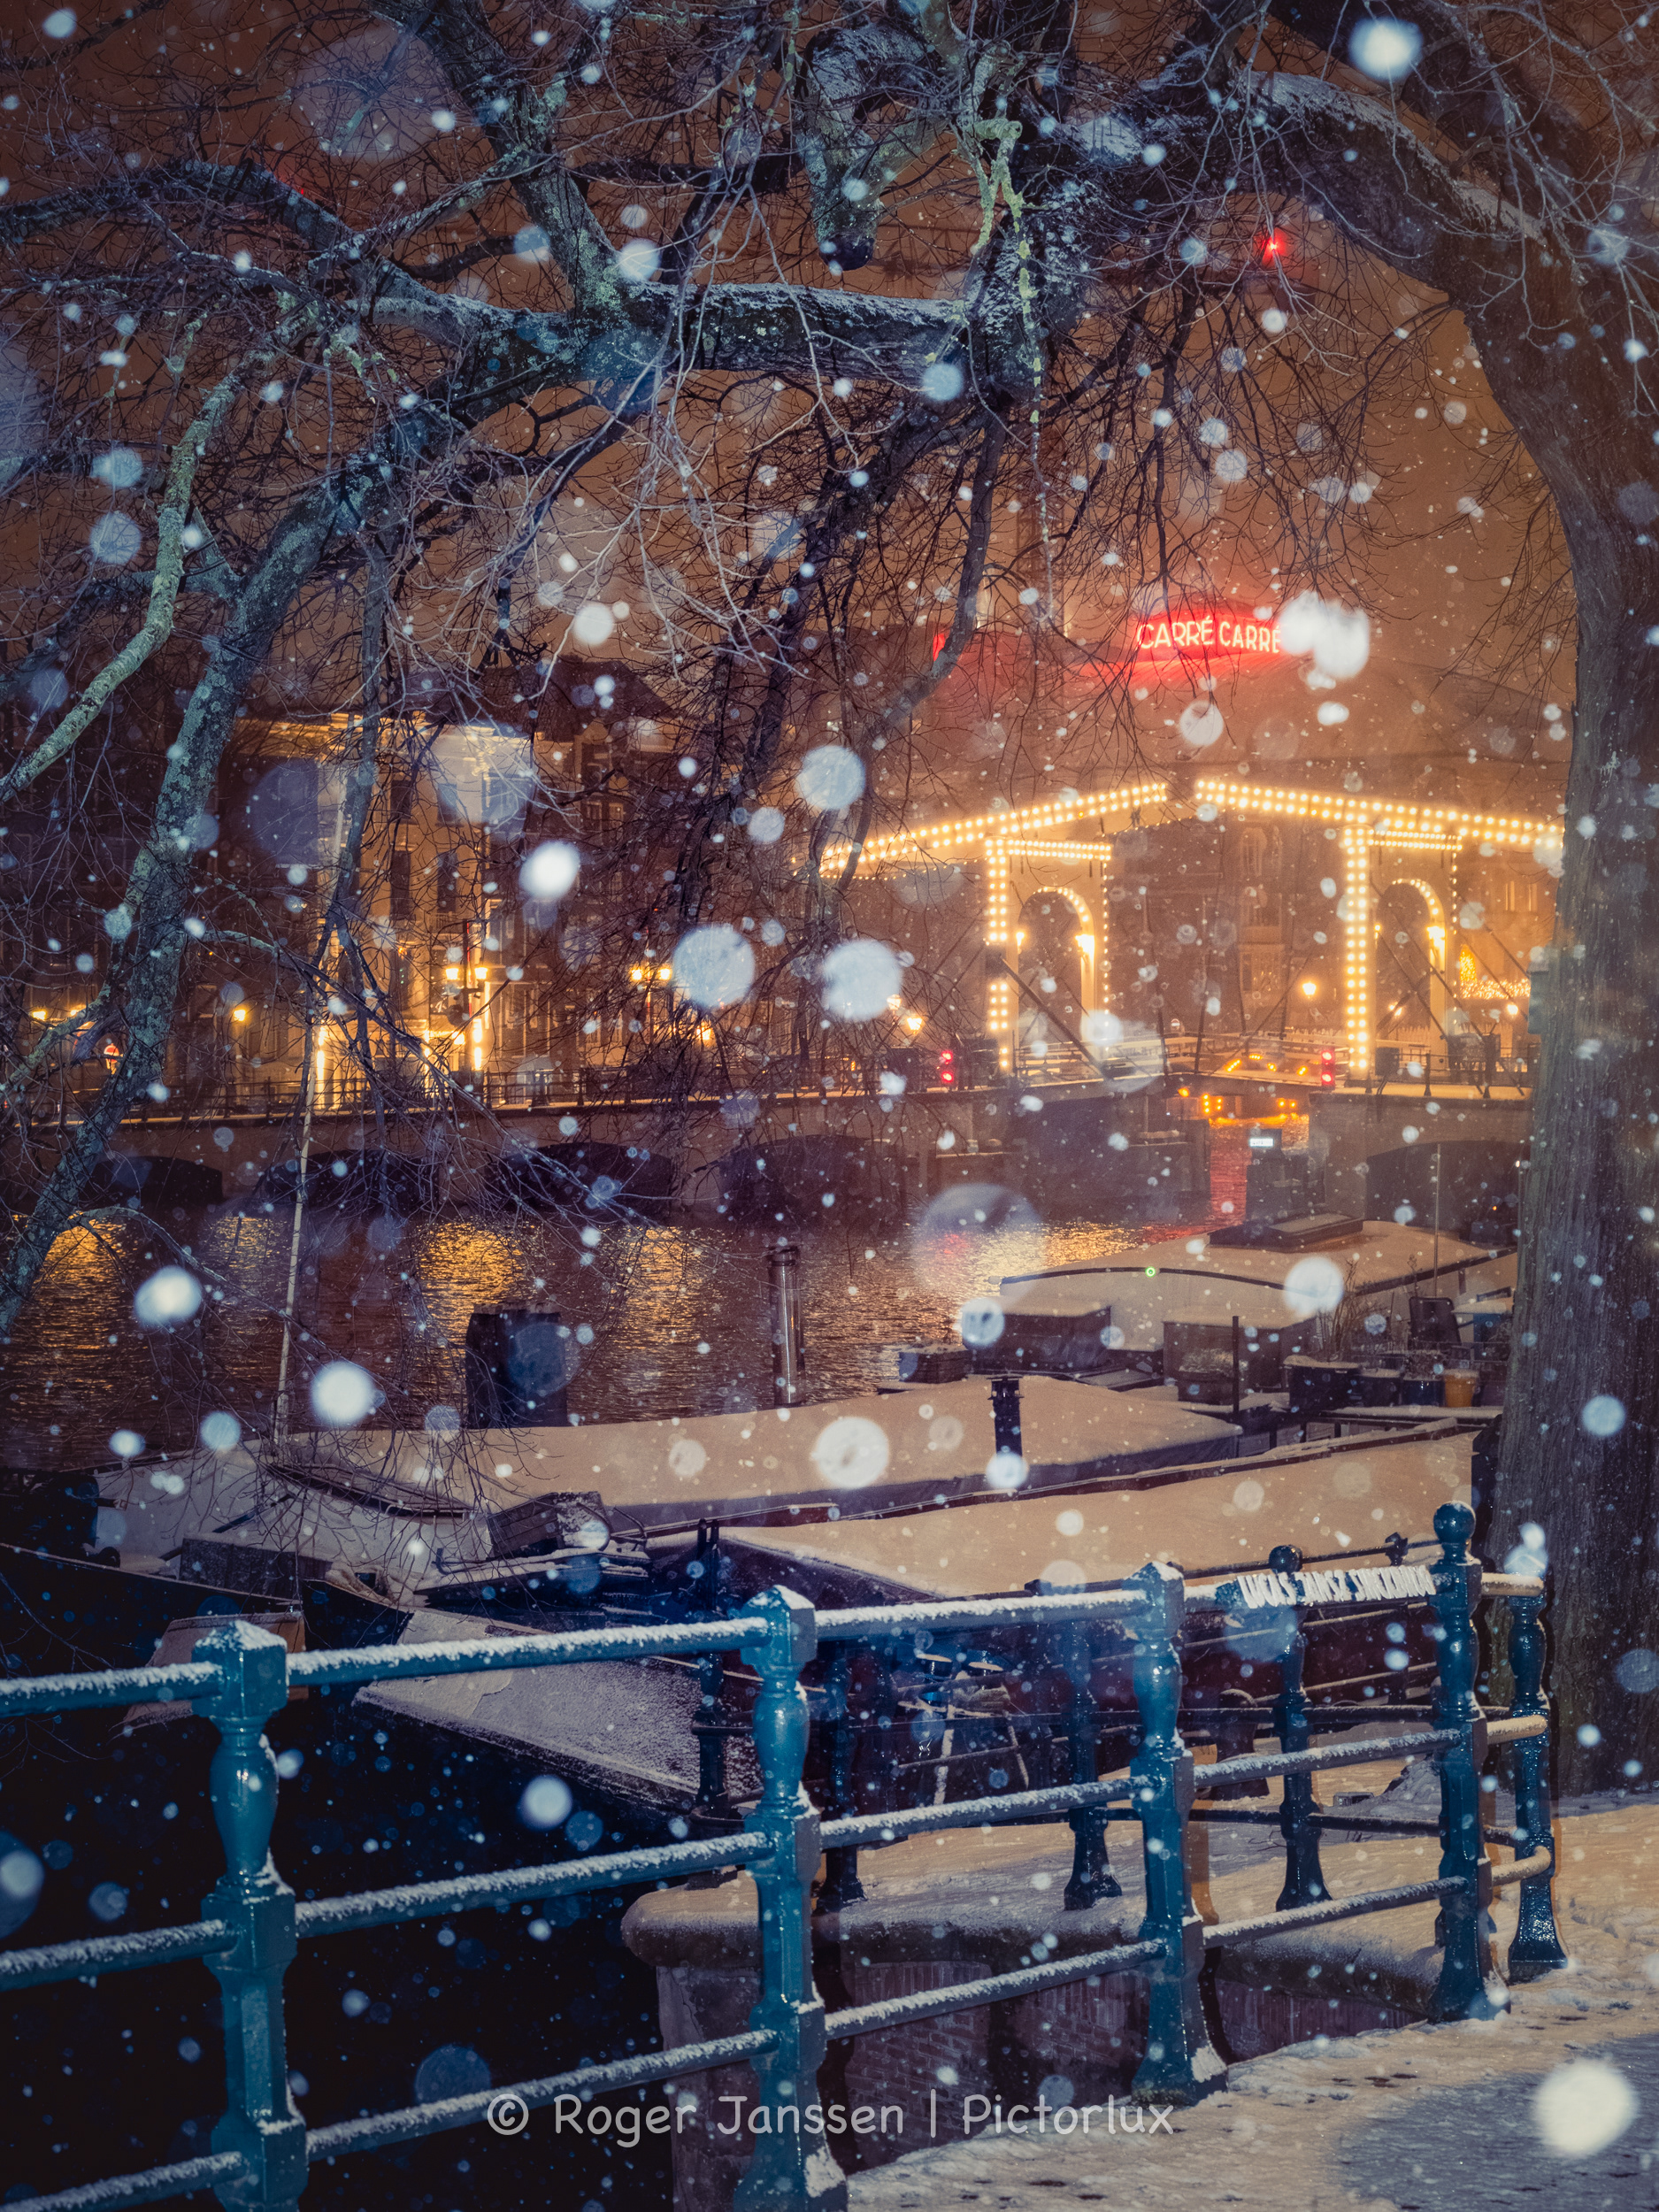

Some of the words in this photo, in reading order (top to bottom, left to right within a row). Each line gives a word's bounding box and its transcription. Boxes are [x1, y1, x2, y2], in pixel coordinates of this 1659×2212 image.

[1137, 616, 1213, 649] CARRÉ
[1219, 621, 1282, 653] CARRÉ
[1237, 1571, 1297, 1609] LUCAS
